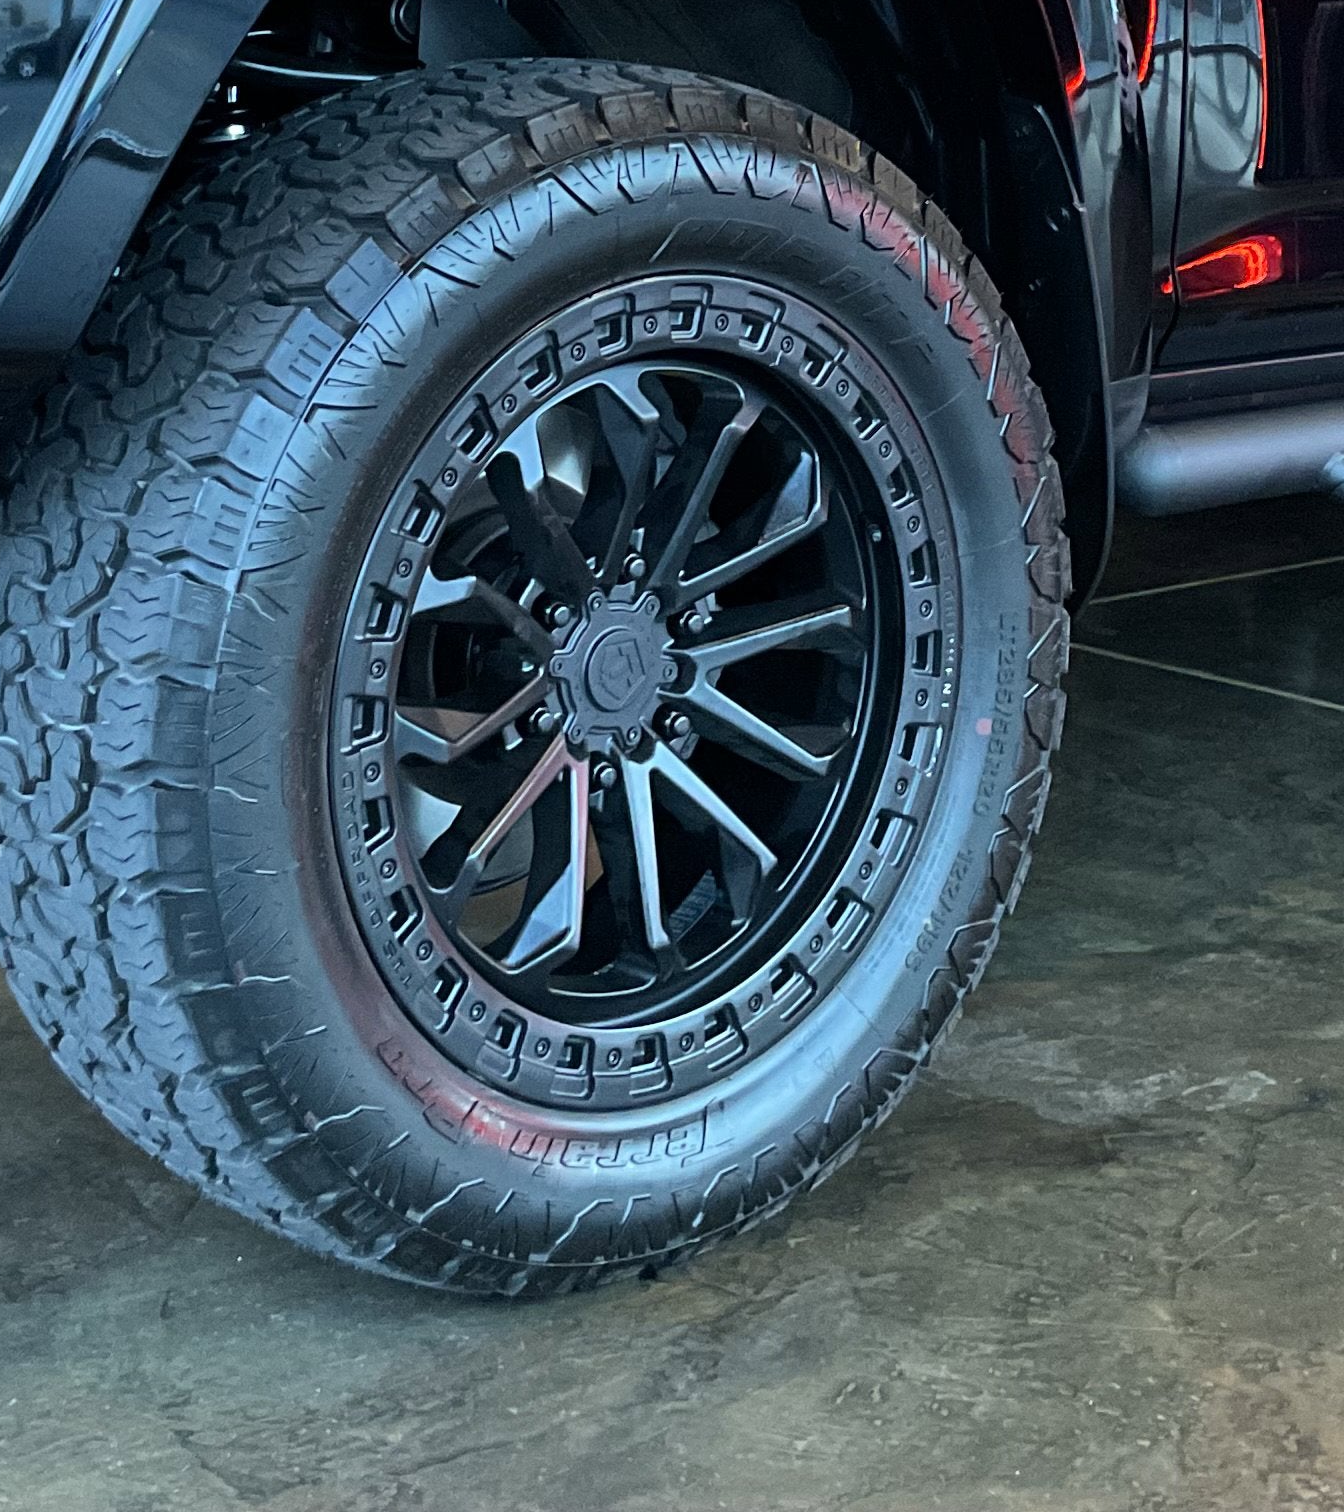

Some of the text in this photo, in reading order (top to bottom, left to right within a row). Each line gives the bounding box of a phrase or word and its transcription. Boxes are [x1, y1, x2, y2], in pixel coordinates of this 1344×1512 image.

[339, 768, 415, 990] TIS OFFROAD
[508, 1105, 735, 1178] Terrain
